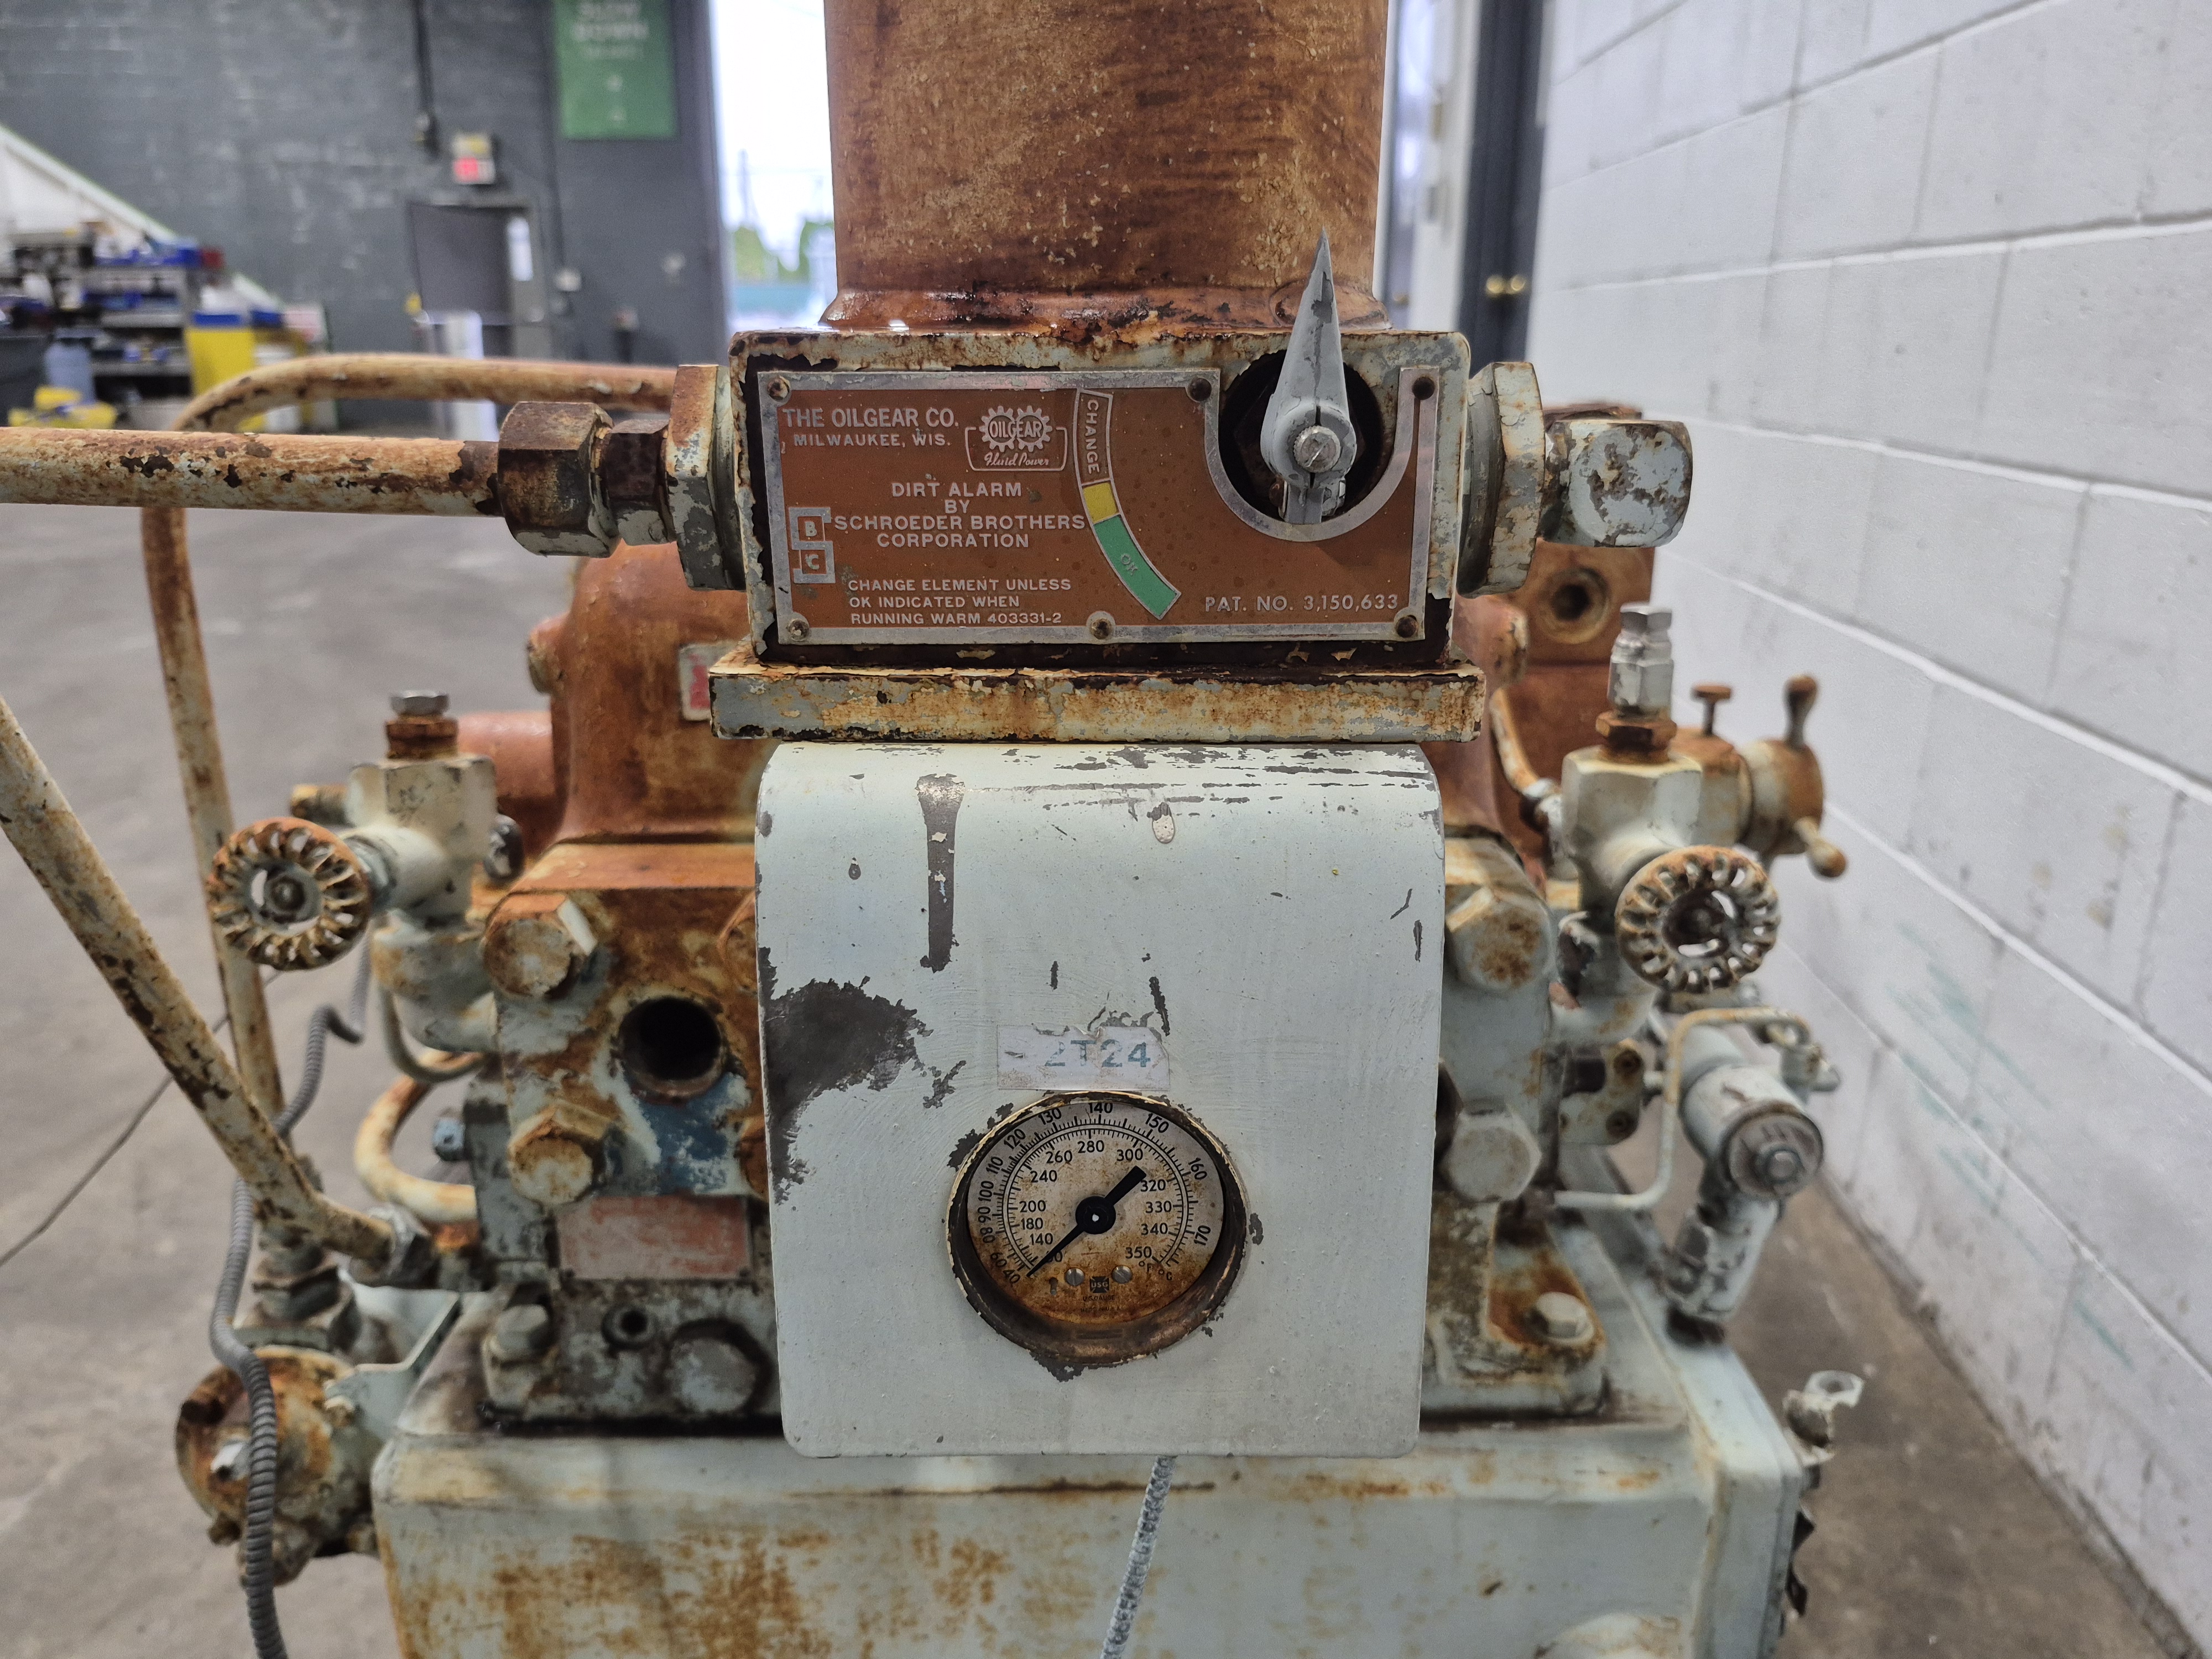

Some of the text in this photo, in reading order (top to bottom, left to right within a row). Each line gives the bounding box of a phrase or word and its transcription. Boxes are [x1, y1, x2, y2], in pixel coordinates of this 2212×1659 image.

[782, 408, 959, 428] THE OILGEAR CO.
[989, 420, 1042, 439] OILGEAR
[1085, 399, 1100, 474] CHANGE
[794, 433, 951, 448] MILWAUKEE, WIS.
[984, 452, 1049, 466] Fluid Power
[891, 483, 1022, 497] DIRT ALARM
[945, 499, 970, 514] BY
[834, 515, 1086, 530] SCHROEDER BROTHERS
[877, 534, 1029, 548] CORPORATION
[1120, 554, 1138, 576] OK
[848, 579, 1071, 591] CHANGE ELEMENT UNLESS
[849, 596, 1020, 608] OK INDICATED WHEN
[1205, 594, 1397, 612] PAT. NO. 3,150,633
[851, 612, 1062, 625] RUNNING WARM 403331-2
[1088, 1102, 1113, 1113] 140
[1039, 1108, 1062, 1125] 130
[1145, 1113, 1170, 1133] 150
[1004, 1128, 1026, 1150] 120
[1077, 1140, 1104, 1153] 280
[1046, 1150, 1073, 1164] 260
[1117, 1148, 1143, 1162] 300
[986, 1156, 1004, 1174] 110
[1188, 1157, 1207, 1180] 160
[1030, 1170, 1057, 1183] 240
[978, 1180, 994, 1202] 100
[1140, 1179, 1166, 1192] 320
[1019, 1200, 1046, 1213] 200
[1145, 1201, 1172, 1213] 330
[977, 1206, 992, 1223] 90
[1022, 1217, 1044, 1230] 180
[1141, 1223, 1168, 1235] 340
[979, 1227, 995, 1243] 80
[1030, 1233, 1053, 1245] 140
[1193, 1225, 1211, 1245] 170
[990, 1252, 1008, 1267] 60
[1125, 1246, 1152, 1259] 350
[1002, 1268, 1021, 1284] 40
